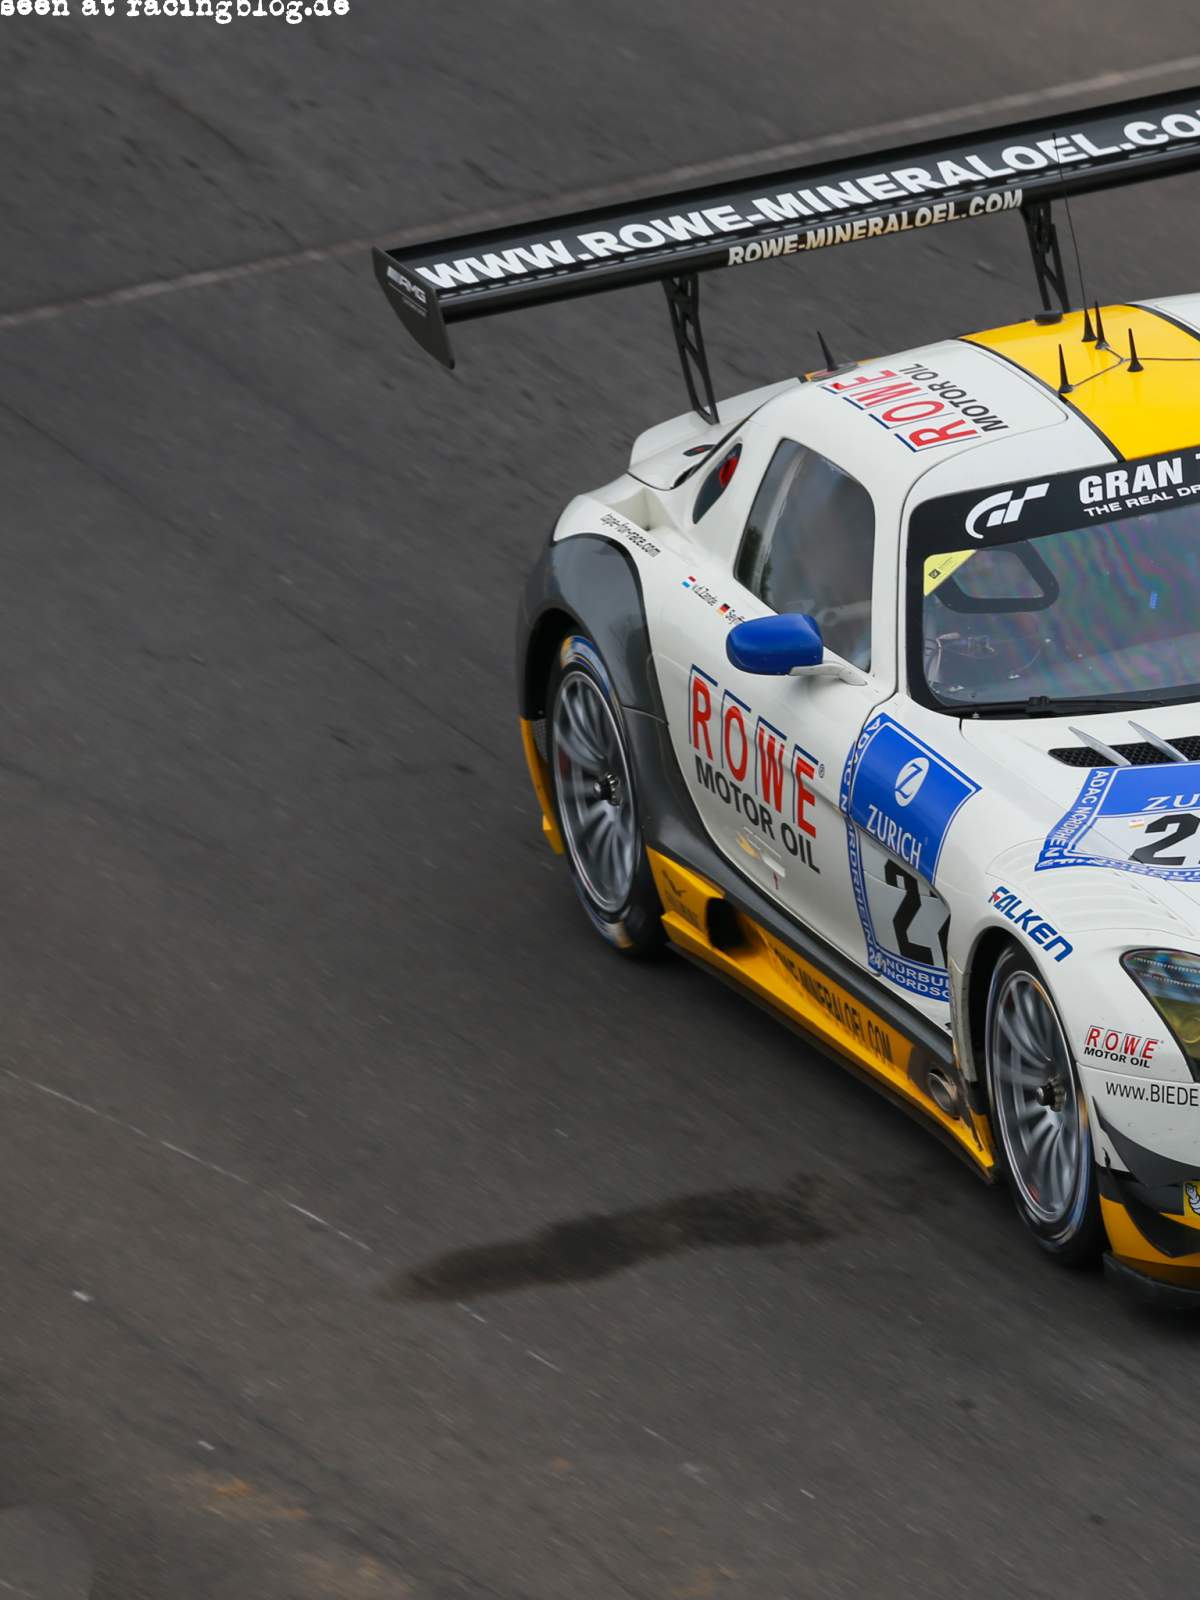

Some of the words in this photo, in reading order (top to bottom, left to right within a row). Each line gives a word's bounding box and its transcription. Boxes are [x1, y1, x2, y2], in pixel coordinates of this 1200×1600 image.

[728, 189, 1022, 266] ROWE-MINERALOEL.COM
[900, 363, 939, 382] OIL
[828, 368, 981, 450] ROWE
[928, 381, 1009, 432] MOTOR
[1079, 457, 1183, 505] GRAN
[1083, 501, 1122, 517] THE
[1128, 489, 1175, 508] REAL
[690, 666, 817, 838] ROWE
[1081, 770, 1110, 804] ADAC
[695, 754, 776, 841] MOTOR
[781, 822, 820, 875] OIL
[866, 803, 923, 870] ZURICH
[988, 885, 1073, 963] FALKEN
[1084, 1046, 1127, 1064] MOTOR
[1130, 1056, 1151, 1069] OIL
[1086, 1026, 1159, 1060] ROWE
